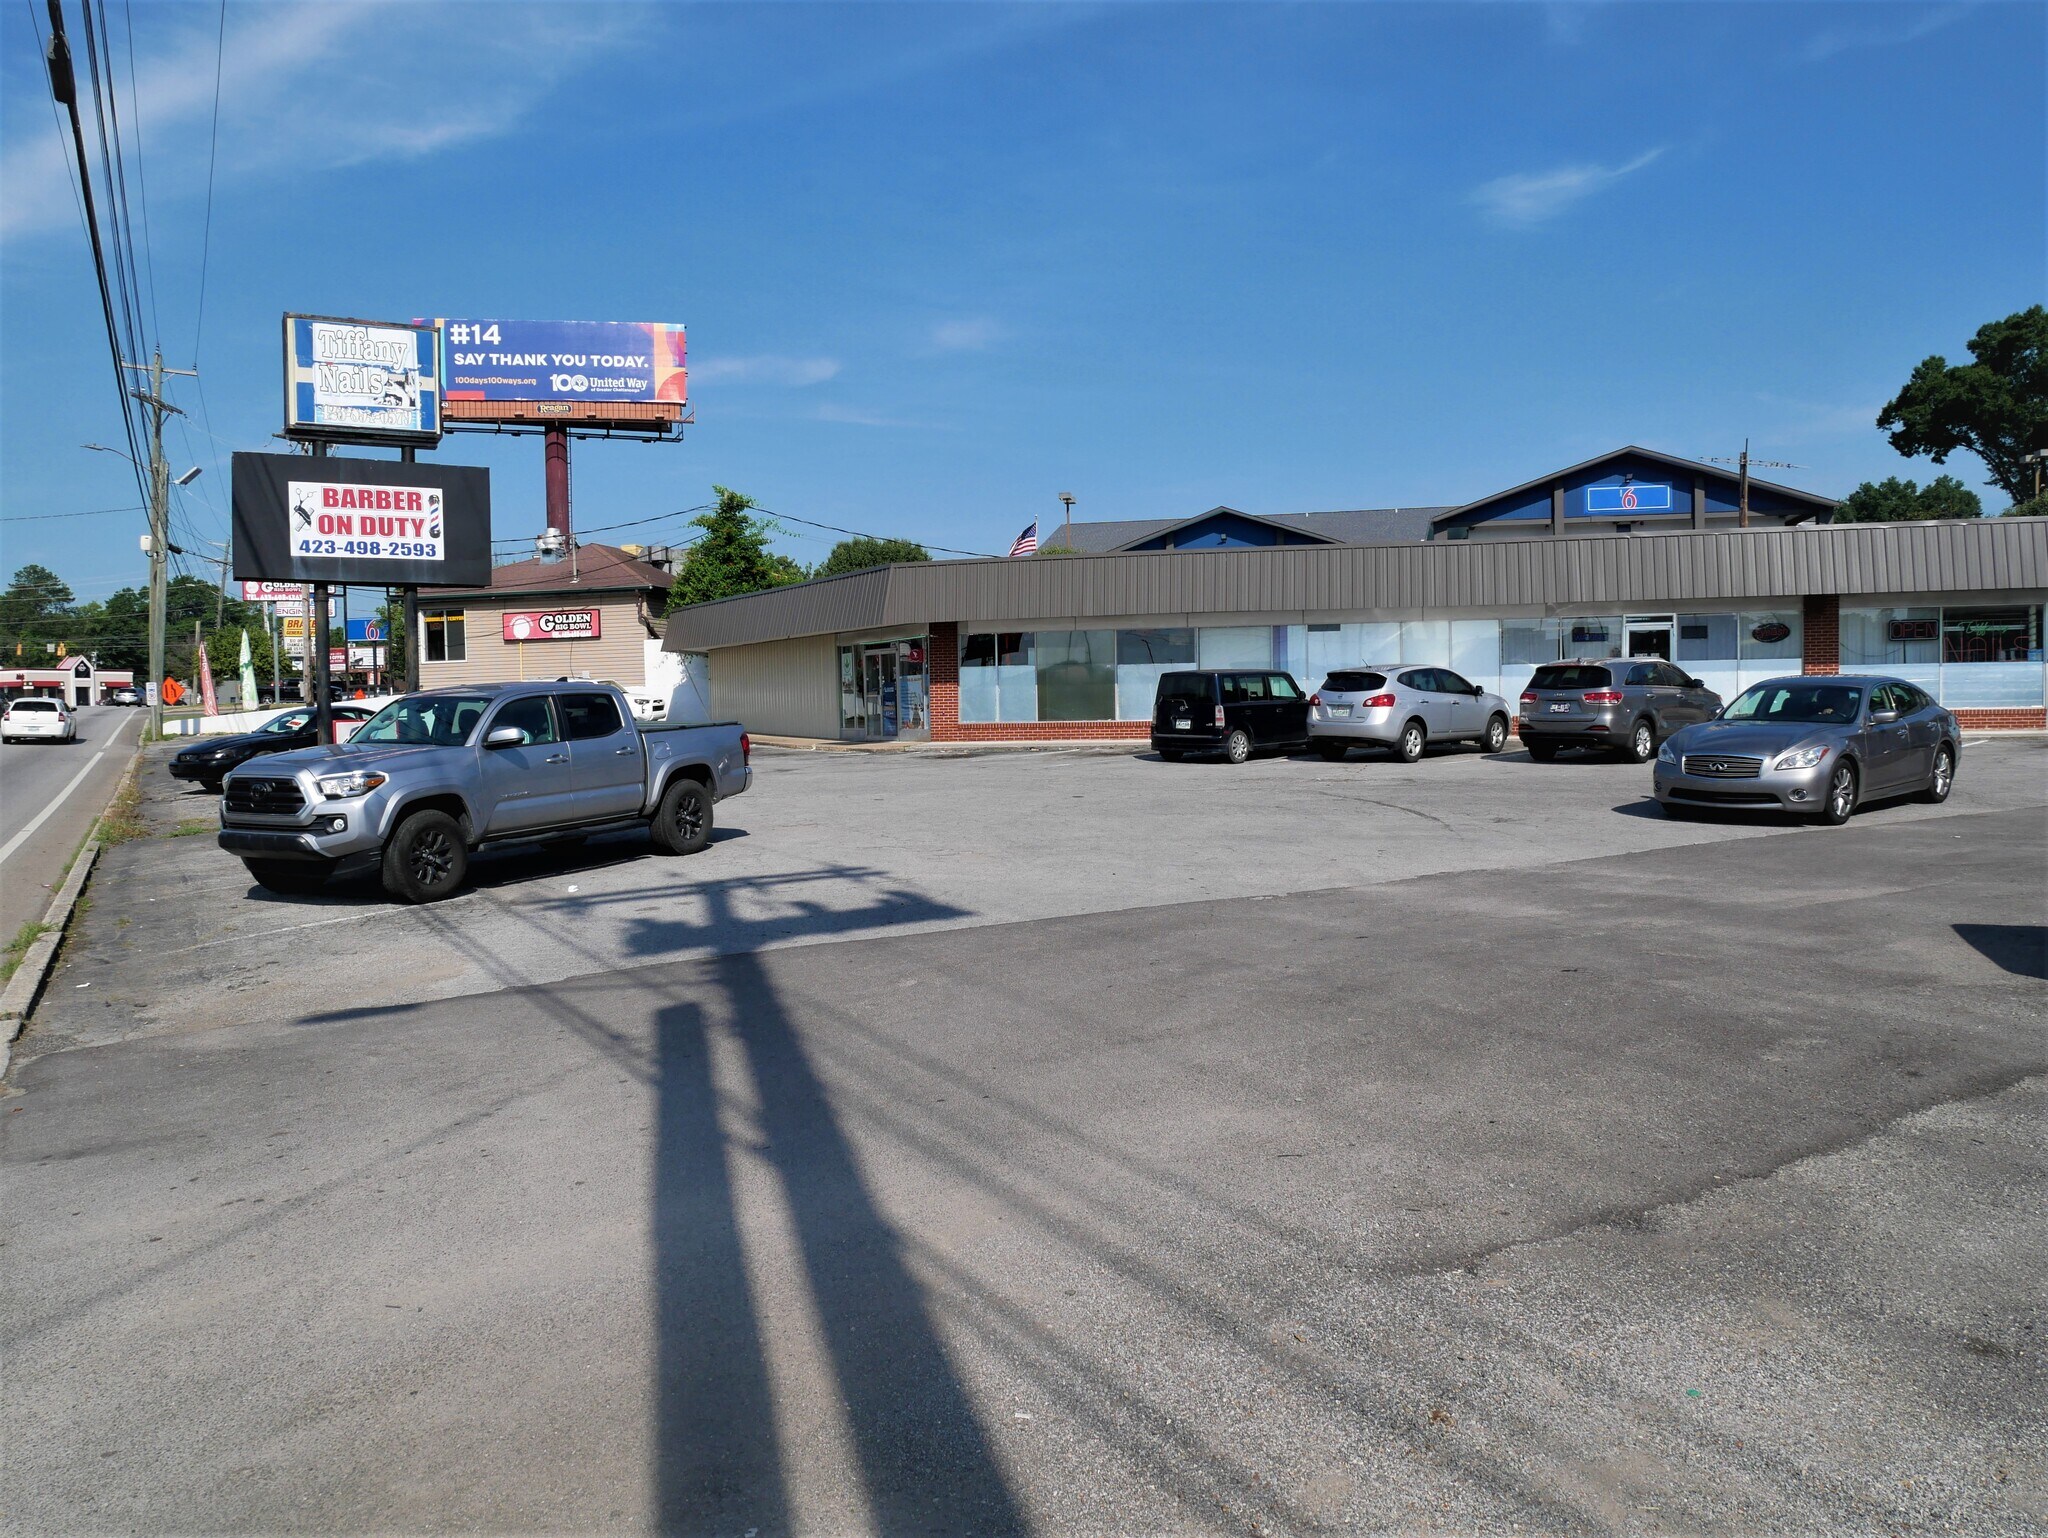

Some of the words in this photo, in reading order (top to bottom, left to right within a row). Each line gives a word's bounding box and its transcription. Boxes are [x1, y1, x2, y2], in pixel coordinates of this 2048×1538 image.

[450, 324, 502, 345] #14
[318, 329, 408, 370] Tiffany
[454, 352, 486, 366] SAY
[489, 353, 548, 366] THANK
[551, 354, 587, 367] YOU
[590, 355, 649, 368] TODAY.
[318, 364, 384, 395] Nails
[454, 377, 537, 386] 100days100ways.org
[590, 377, 625, 388] United
[626, 378, 648, 390] Way
[540, 404, 570, 413] Reagan
[322, 487, 423, 511] BARBER
[1621, 486, 1638, 509] 6
[317, 514, 354, 535] ON
[360, 516, 426, 538] DUTY
[299, 539, 437, 557] 423-498-2593
[261, 582, 302, 593] GOLDEN
[365, 619, 380, 641] 6
[539, 613, 592, 632] GOLDEN
[555, 623, 568, 631] BIG
[569, 622, 592, 630] BOWL
[1891, 622, 1938, 638] OPEN
[1943, 636, 2032, 662] NAILS
